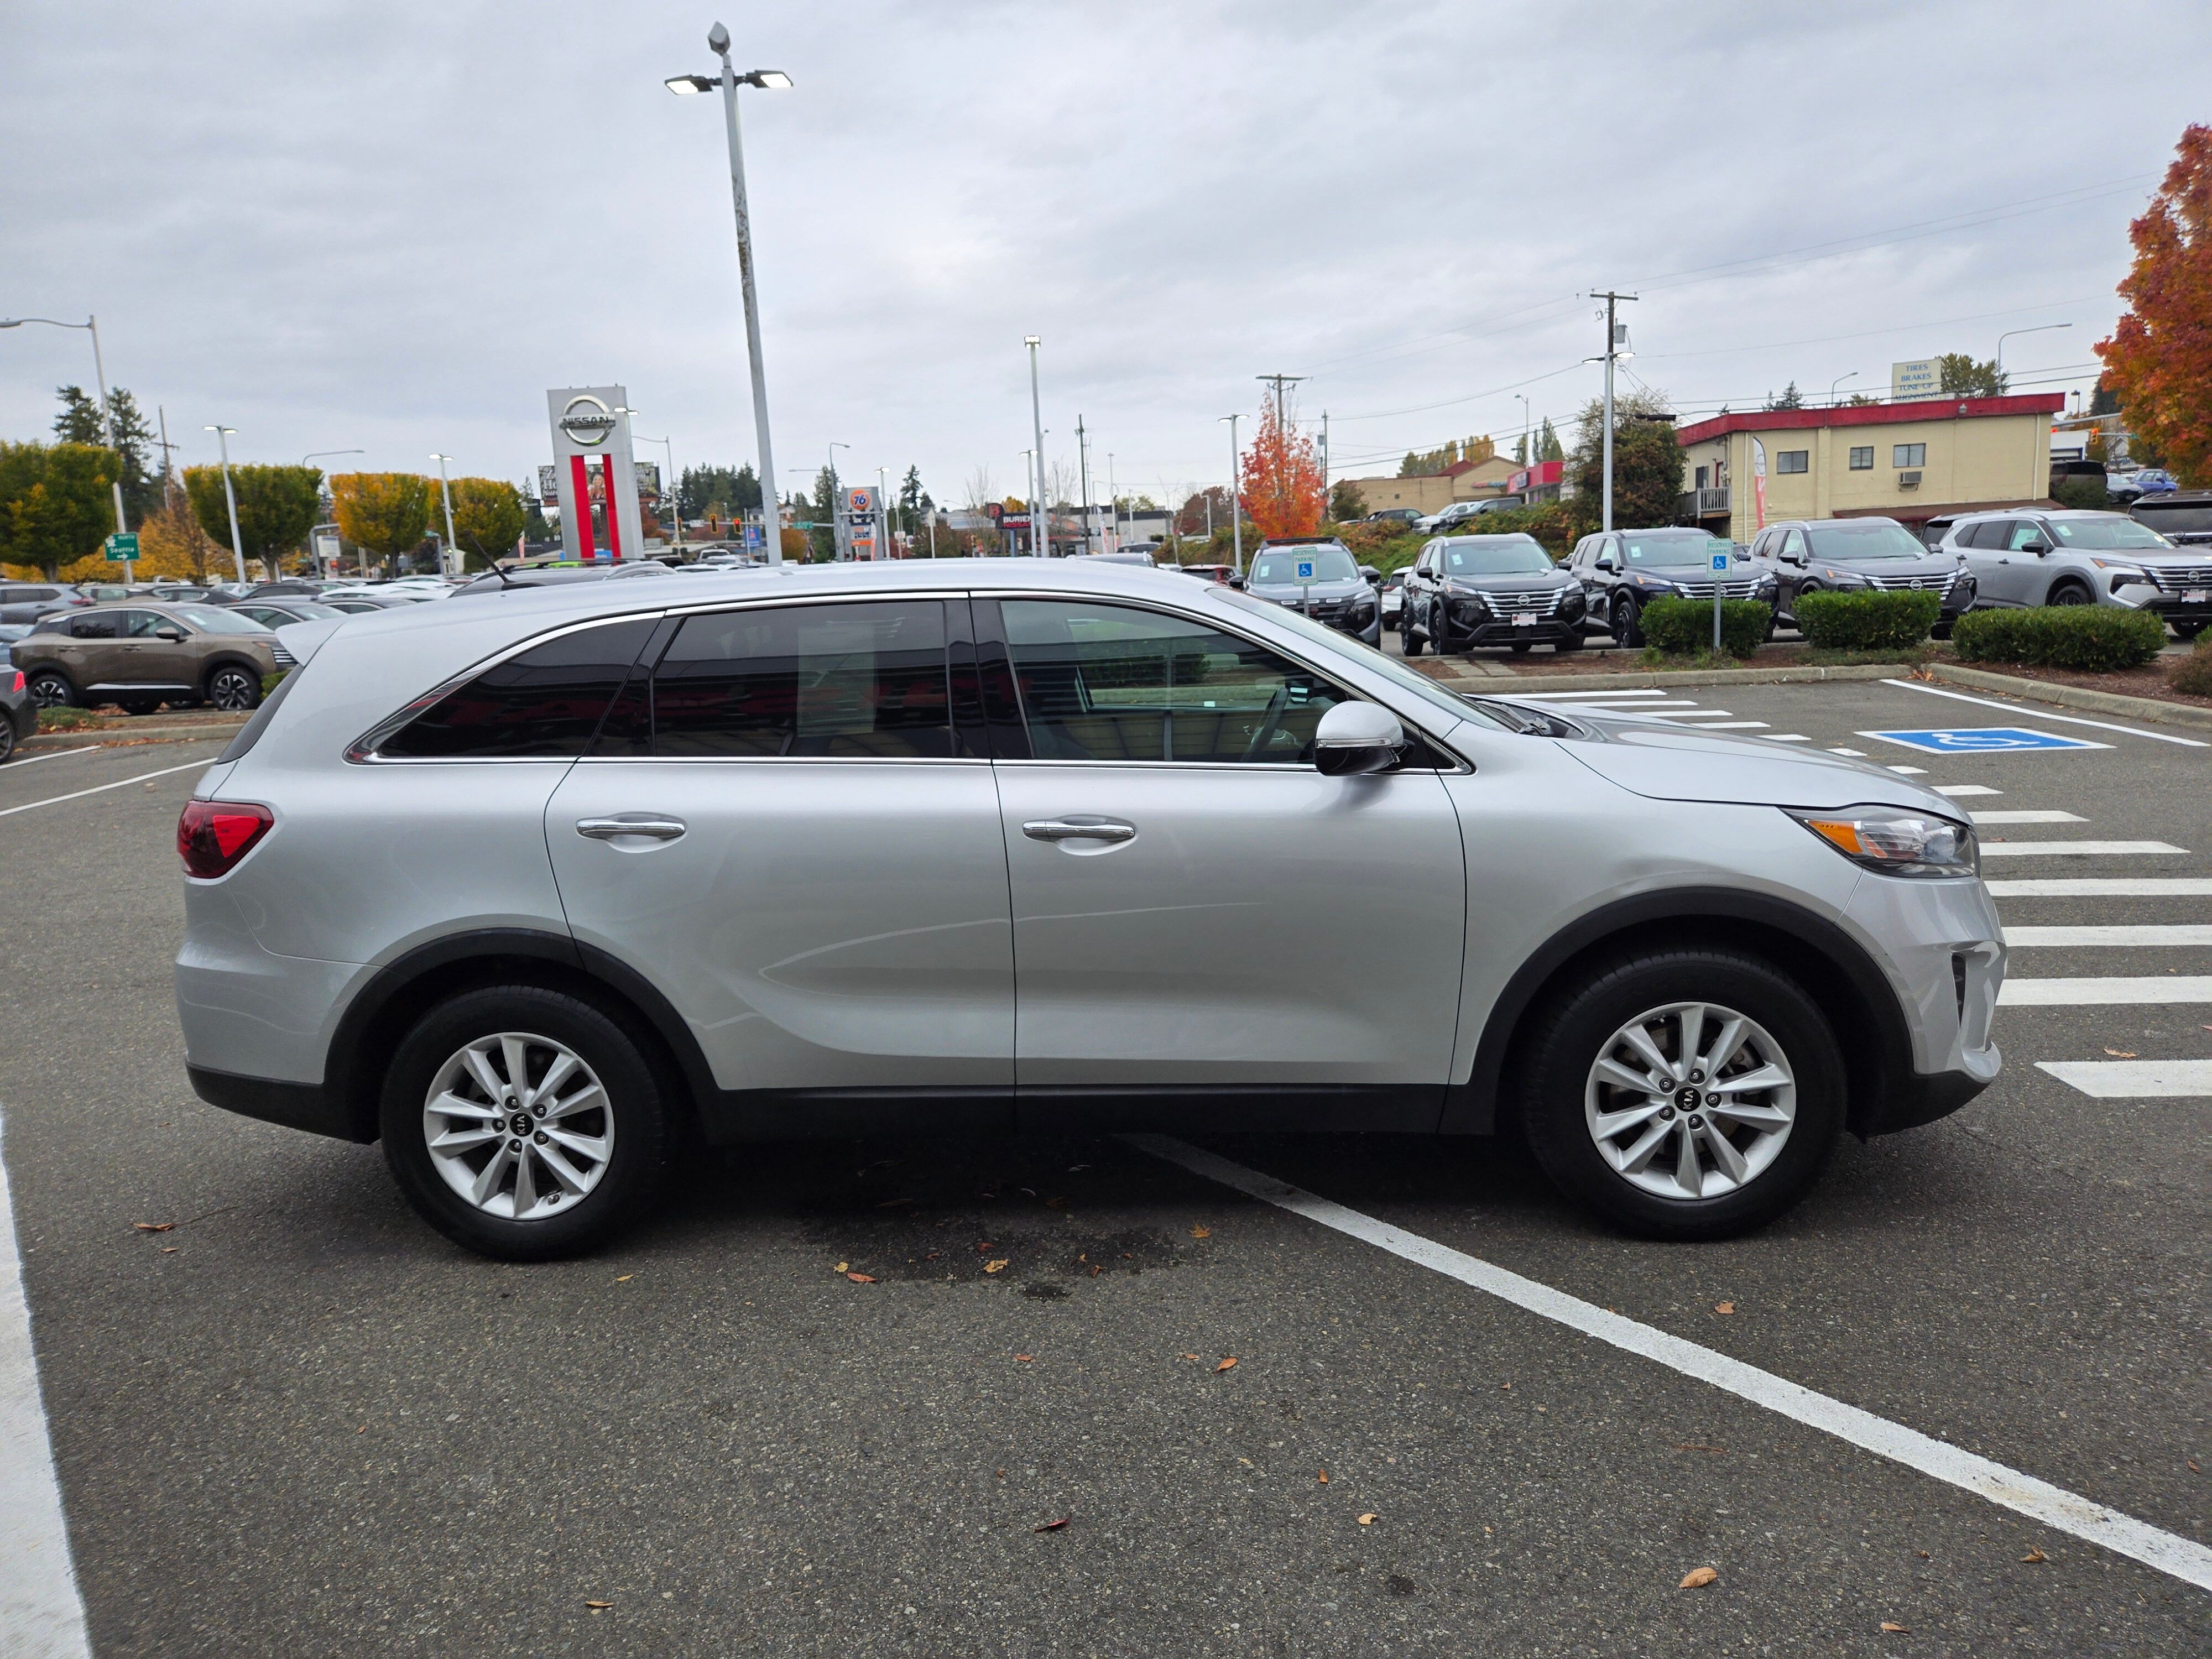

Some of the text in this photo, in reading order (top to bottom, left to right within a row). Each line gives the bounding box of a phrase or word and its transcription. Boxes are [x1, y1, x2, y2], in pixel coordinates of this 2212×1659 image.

[1906, 363, 1928, 372] TIRES
[1901, 373, 1932, 382] BRAKES
[563, 416, 609, 426] NISSAN
[854, 495, 866, 504] 76
[1683, 1090, 1693, 1110] KIA
[517, 1115, 526, 1135] KIA
